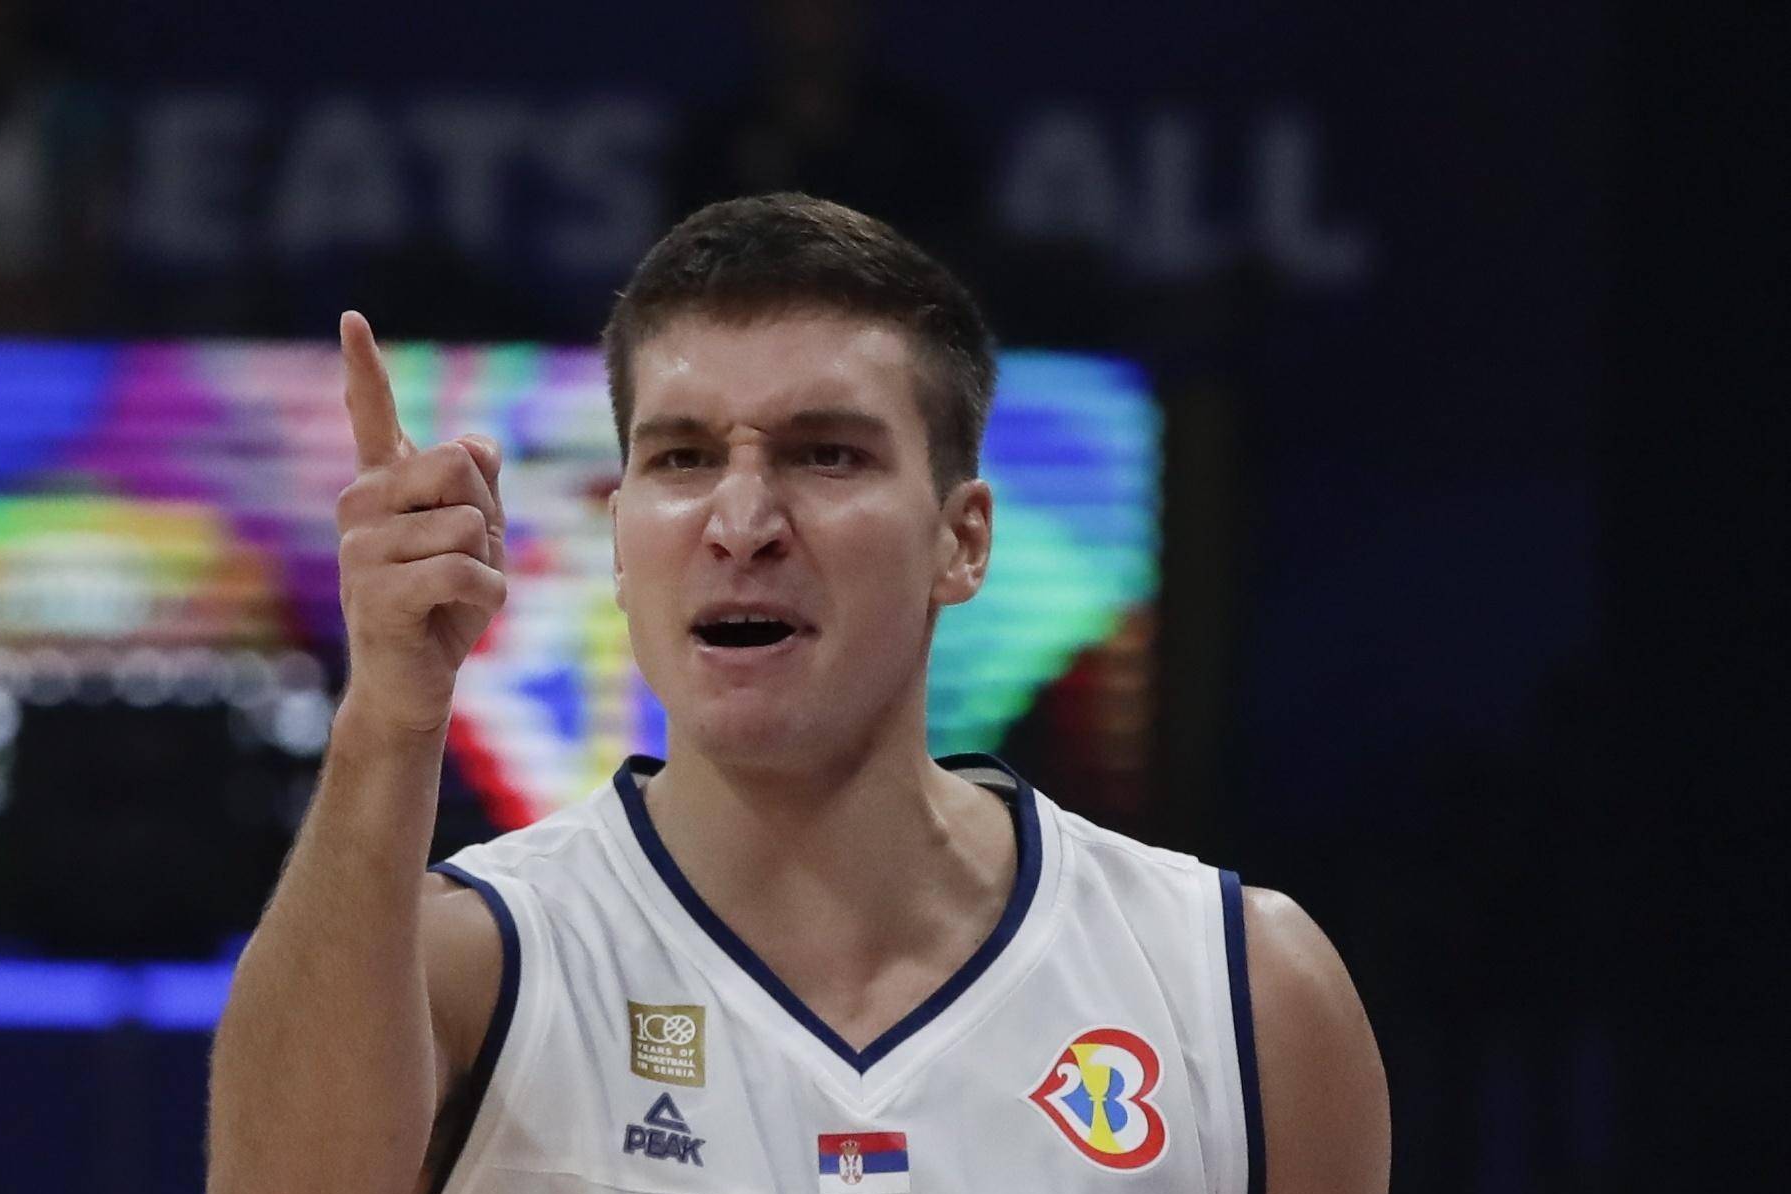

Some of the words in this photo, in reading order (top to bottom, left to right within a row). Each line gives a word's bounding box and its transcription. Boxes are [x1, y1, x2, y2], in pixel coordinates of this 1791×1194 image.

[637, 1042, 673, 1056] YEARS
[679, 1049, 696, 1057] OF
[637, 1052, 696, 1068] BASKETBALL
[637, 1061, 649, 1071] IN
[653, 1065, 696, 1078] SERBIA
[623, 1124, 706, 1167] PEAK
